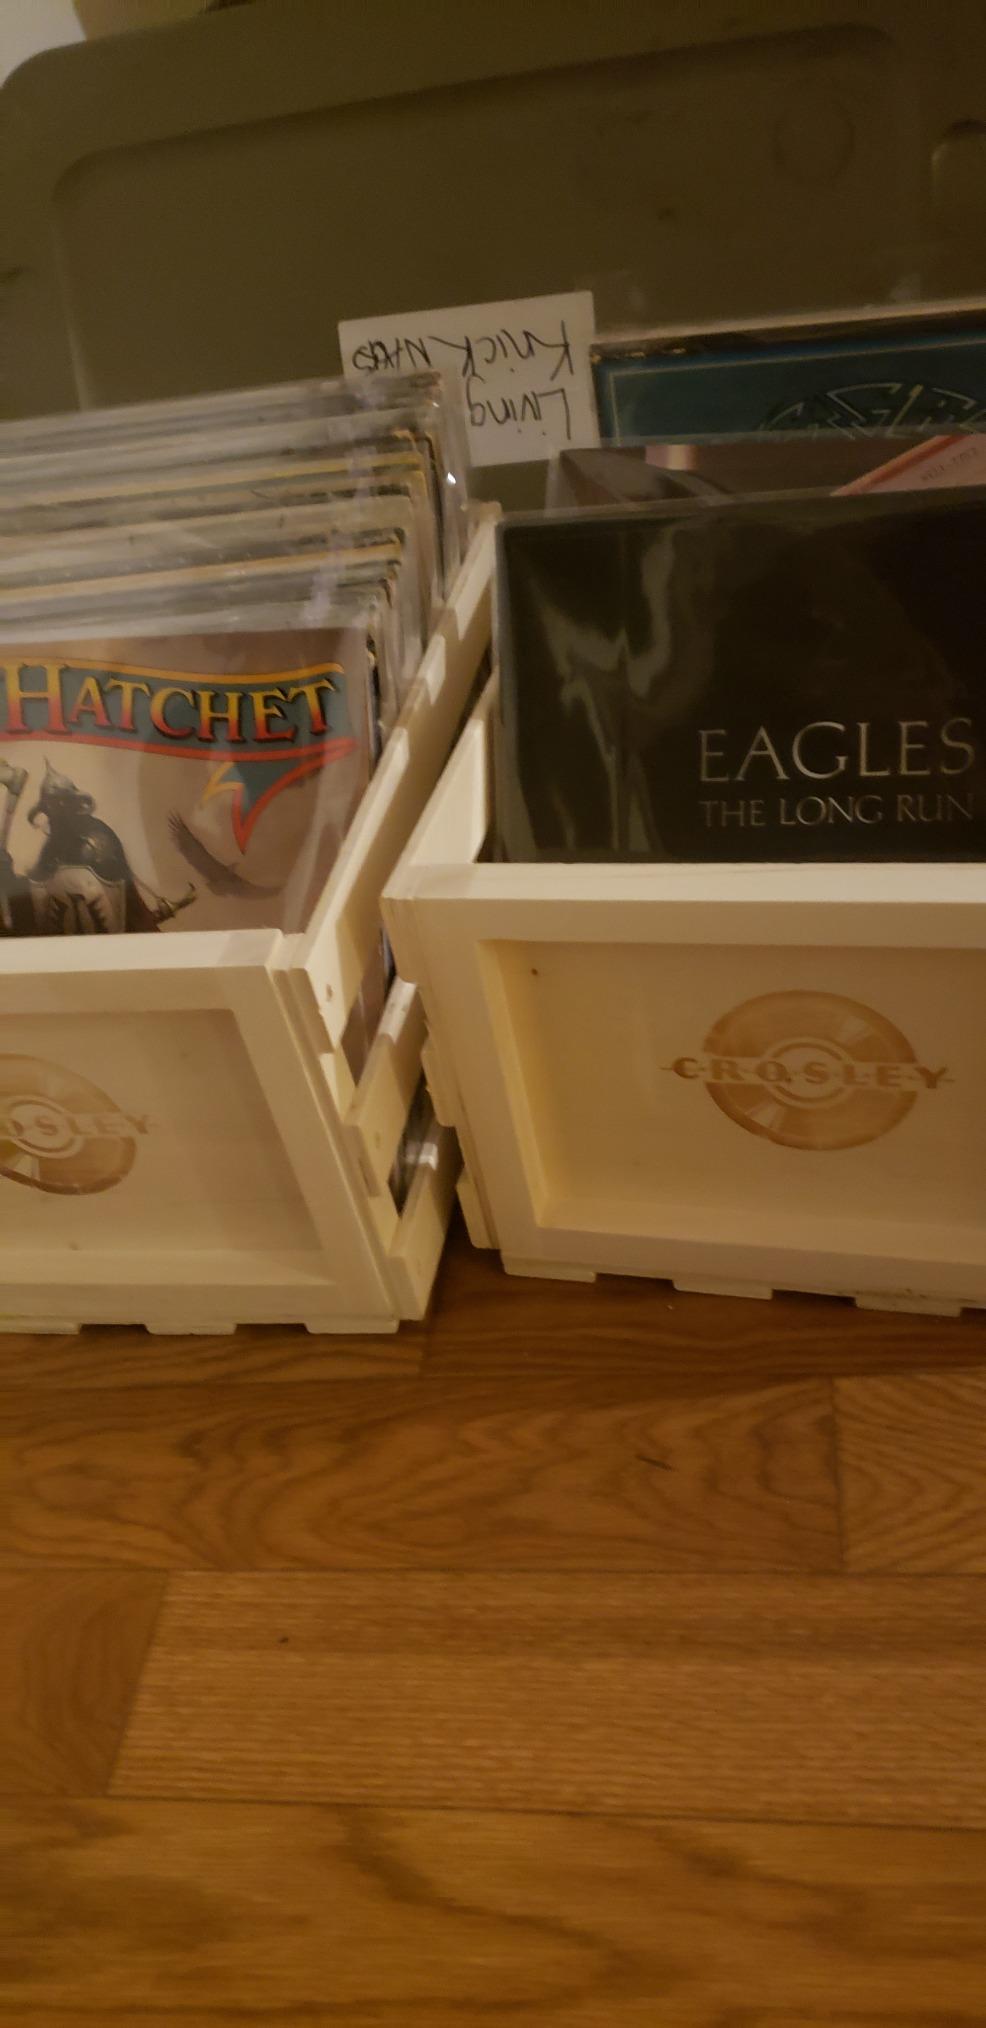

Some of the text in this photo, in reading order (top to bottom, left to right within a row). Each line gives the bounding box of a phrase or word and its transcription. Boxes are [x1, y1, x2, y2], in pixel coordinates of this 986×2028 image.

[466, 374, 571, 440] Living
[1, 663, 336, 743] HATCHET
[698, 717, 975, 782] EAGLES
[699, 793, 973, 828] THE LONG RUN
[671, 1057, 948, 1089] CROSLEY
